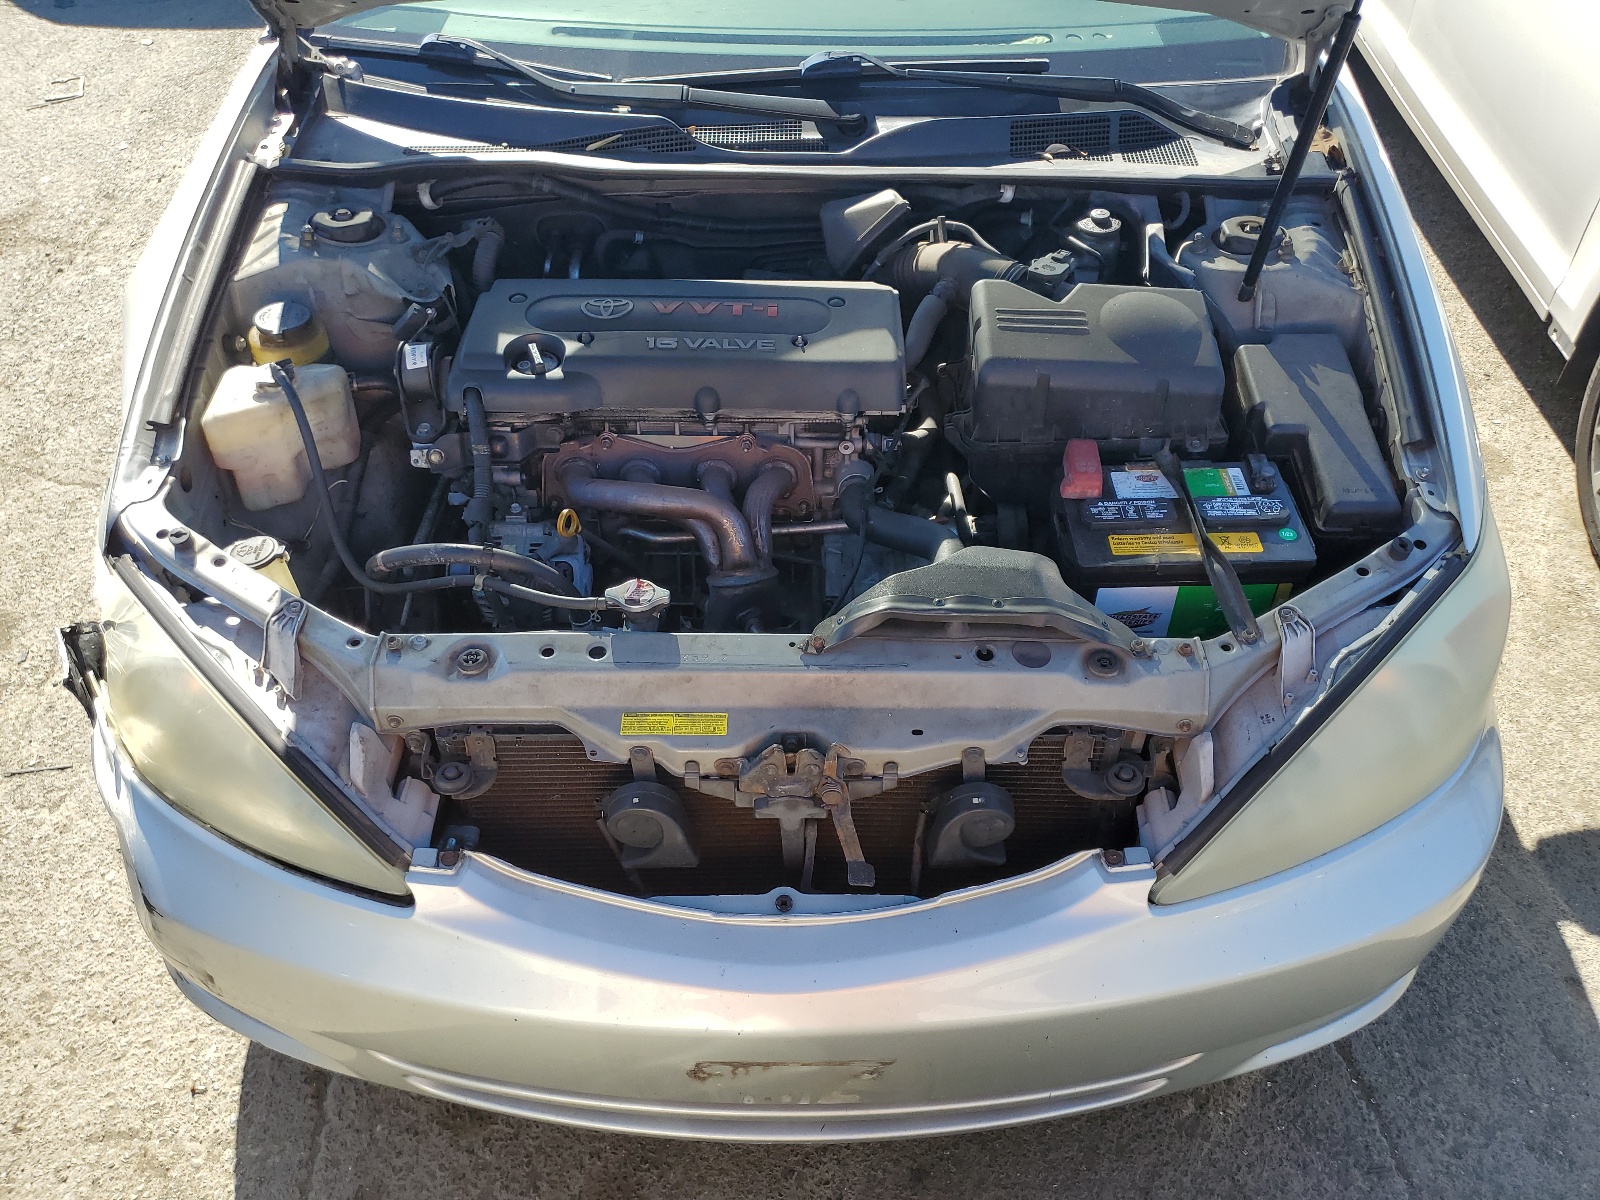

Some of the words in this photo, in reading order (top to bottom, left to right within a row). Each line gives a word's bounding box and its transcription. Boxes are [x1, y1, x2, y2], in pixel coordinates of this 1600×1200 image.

[651, 300, 778, 317] VVT-i
[646, 336, 678, 349] 16
[683, 336, 776, 350] VALVE
